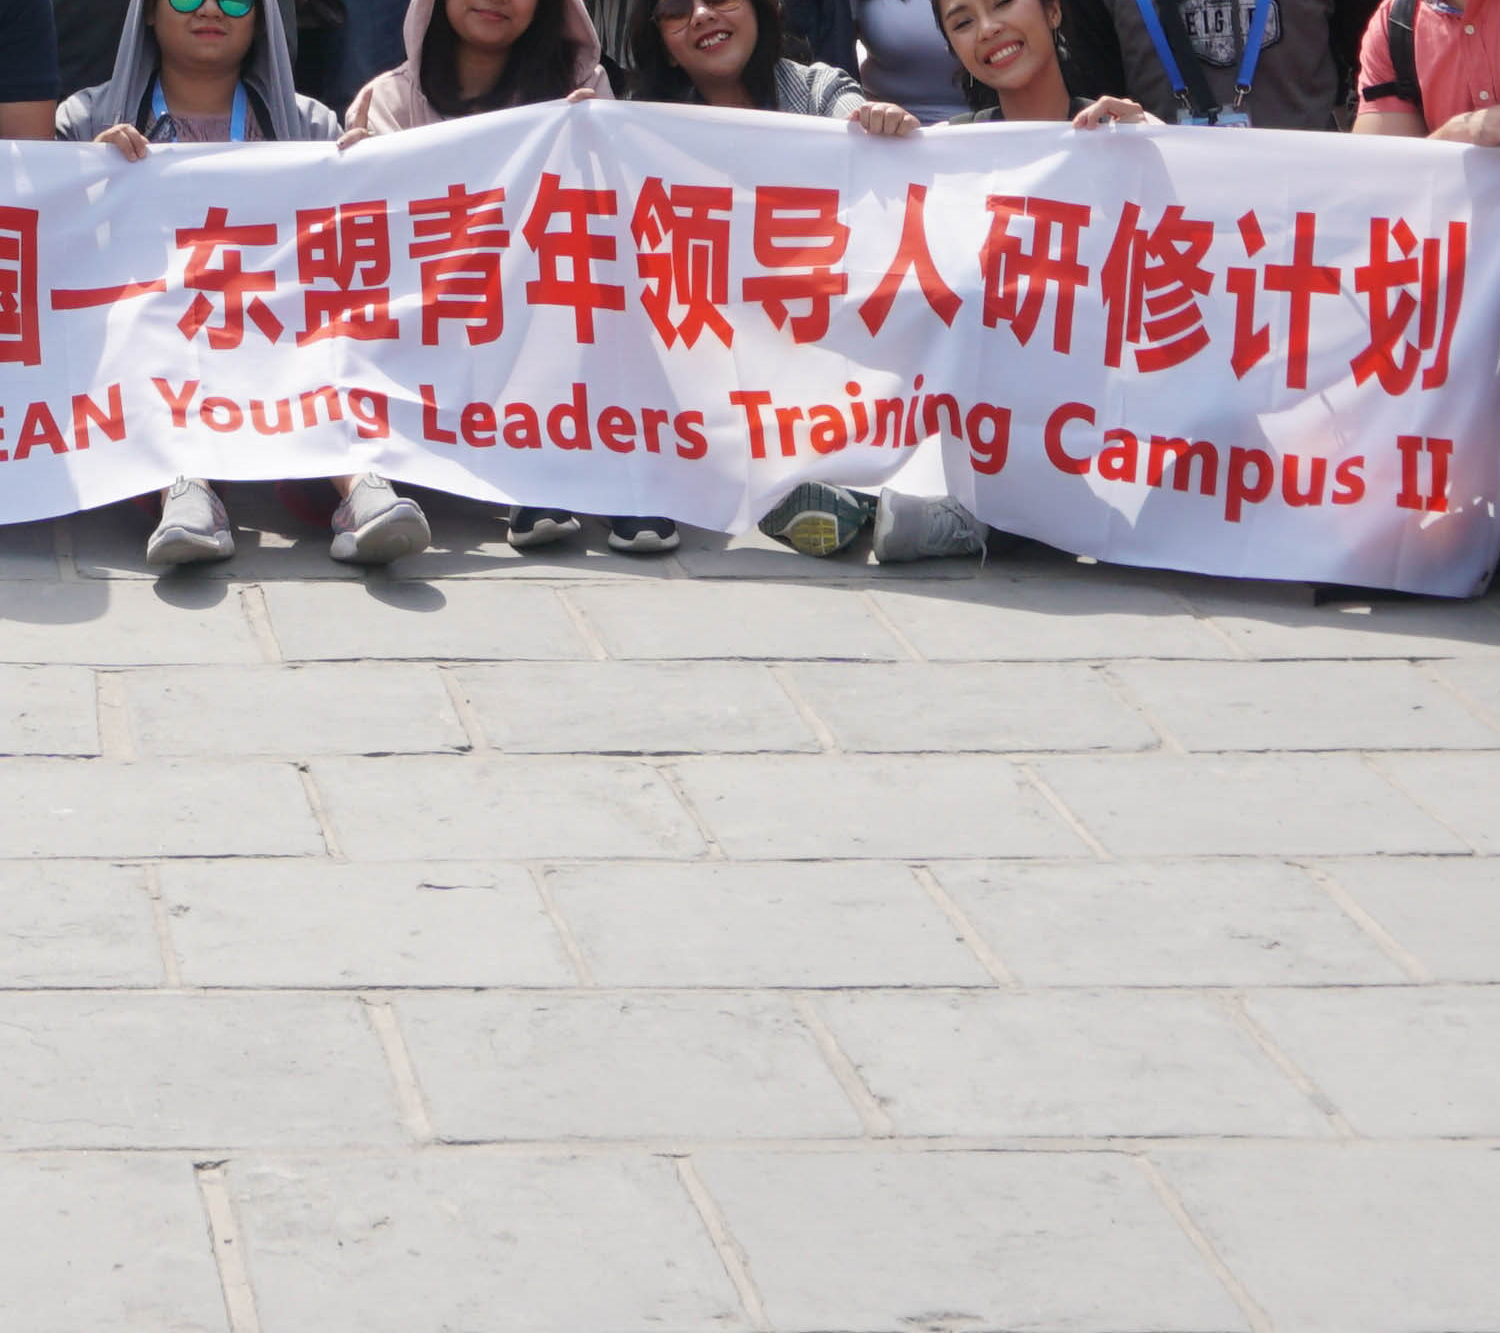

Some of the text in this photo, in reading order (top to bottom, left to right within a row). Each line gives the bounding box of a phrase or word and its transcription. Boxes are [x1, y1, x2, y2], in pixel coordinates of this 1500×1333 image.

[150, 376, 391, 440] Young
[418, 383, 710, 461] Leaders
[727, 373, 1013, 476] Training
[1044, 400, 1368, 523] Campus
[1394, 434, 1455, 515] II
